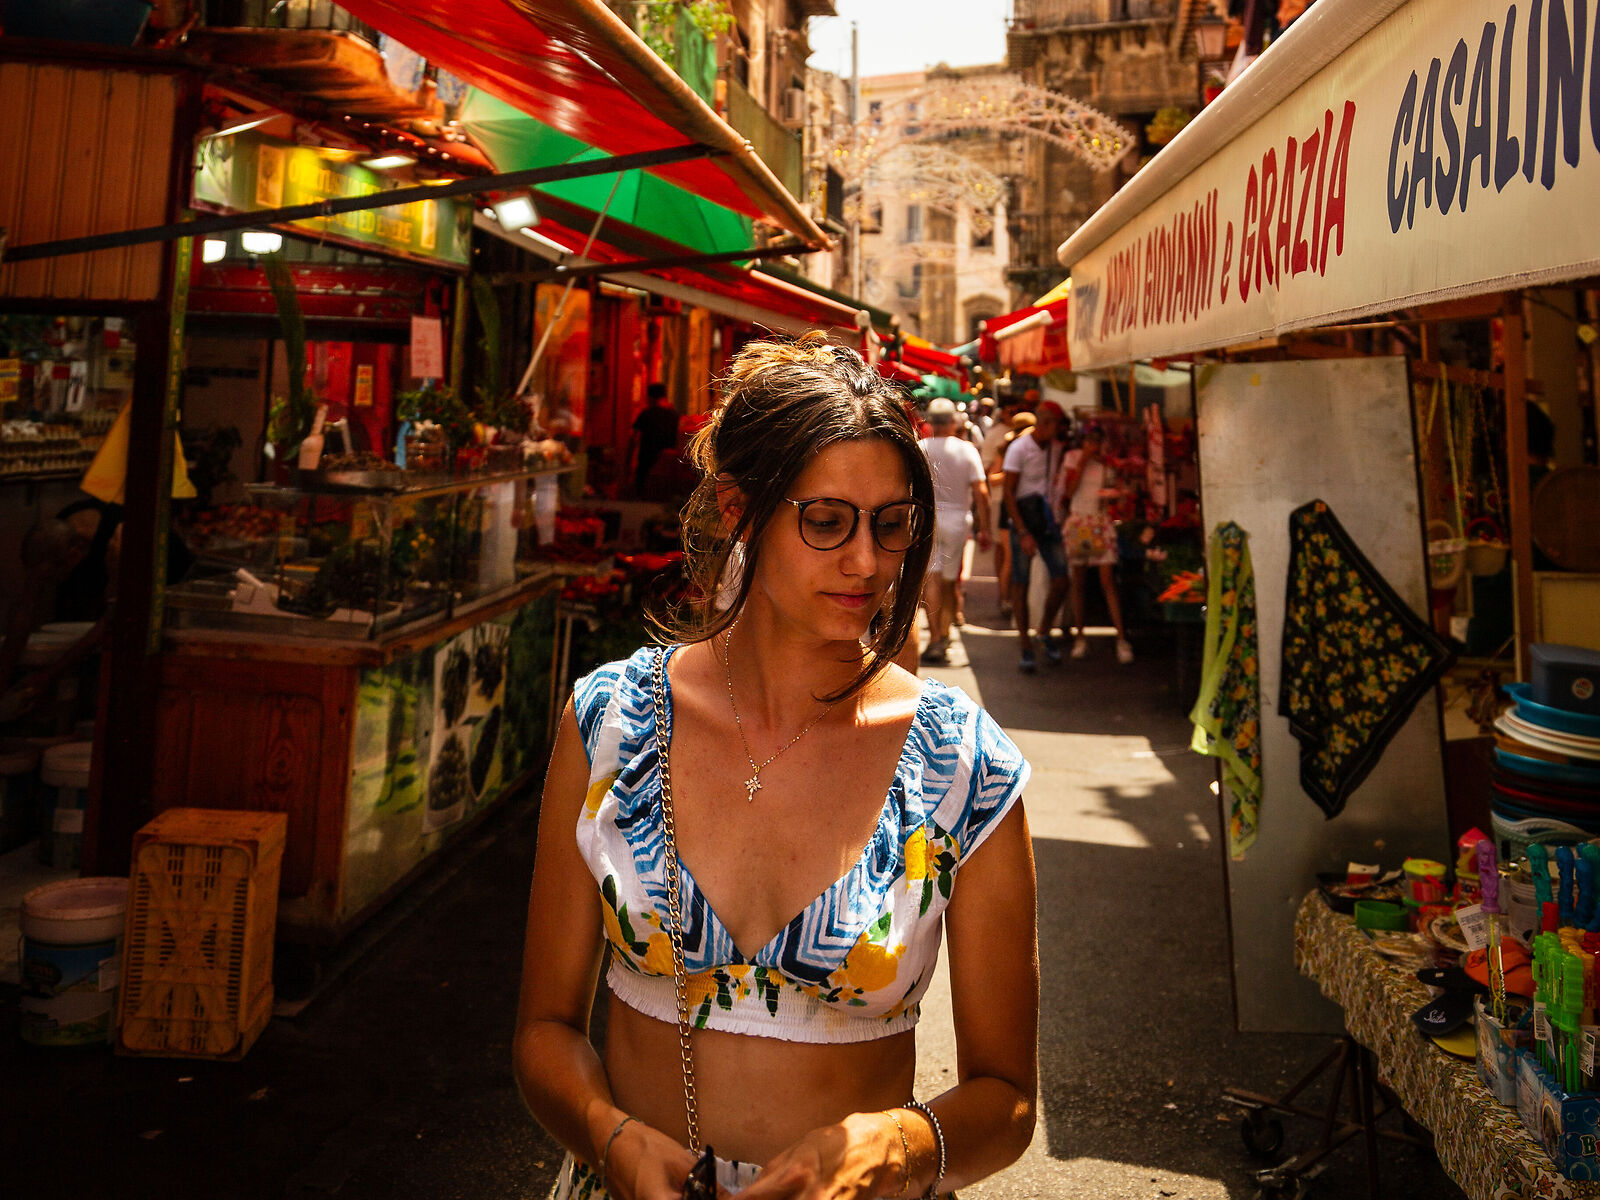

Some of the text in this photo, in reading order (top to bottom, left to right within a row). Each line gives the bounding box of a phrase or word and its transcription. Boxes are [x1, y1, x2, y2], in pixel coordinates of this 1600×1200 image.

[1101, 237, 1141, 343] NAPOLI
[1143, 188, 1218, 328] GIOVANNI
[1220, 220, 1234, 304] e
[1239, 99, 1356, 304] GRAZIA
